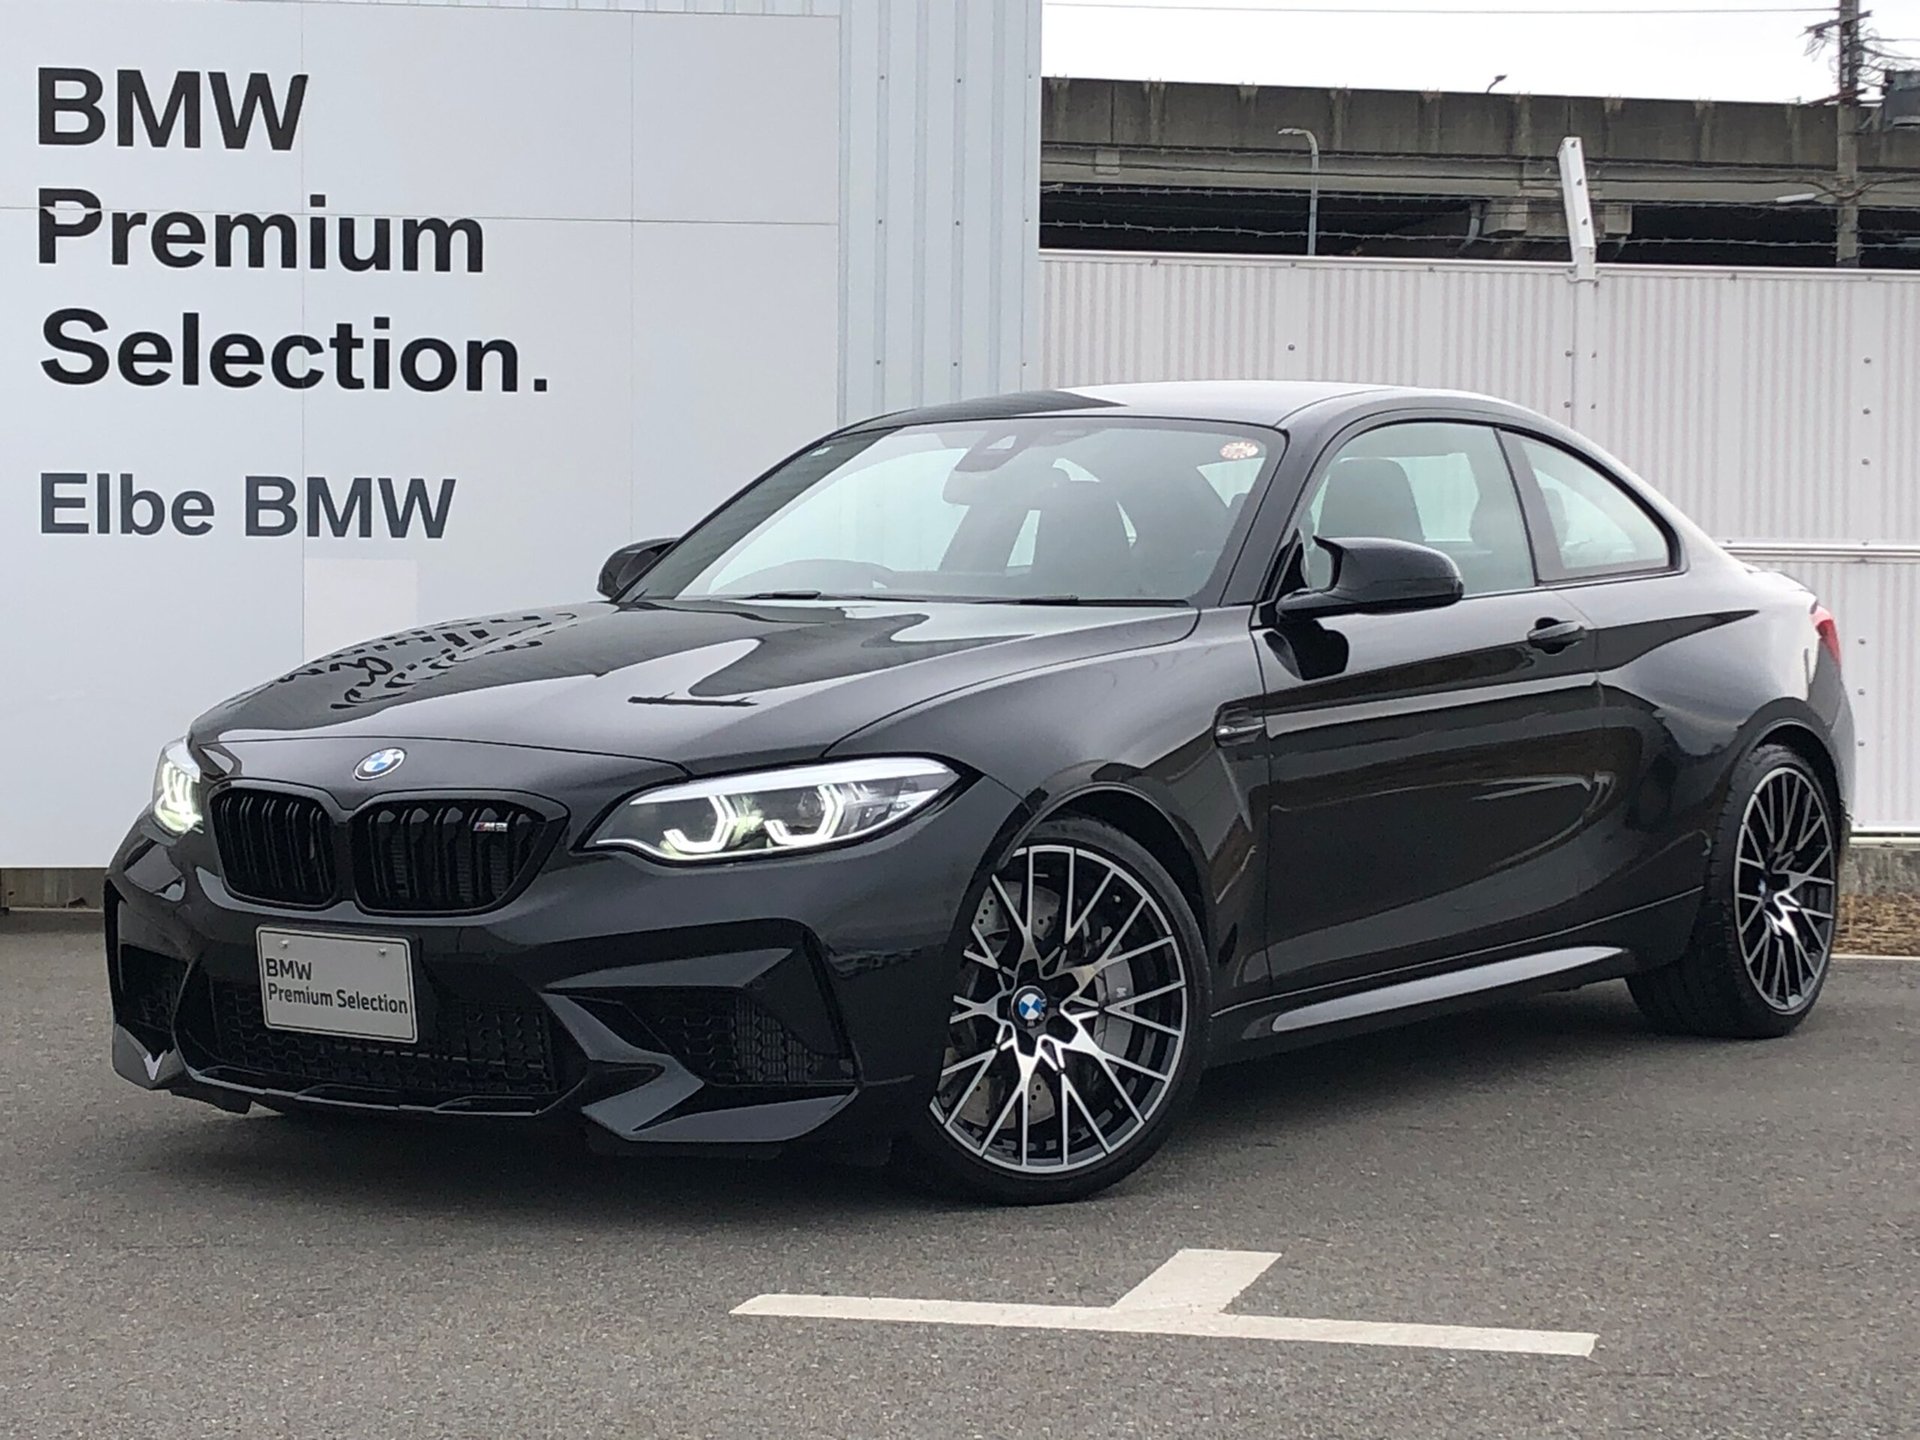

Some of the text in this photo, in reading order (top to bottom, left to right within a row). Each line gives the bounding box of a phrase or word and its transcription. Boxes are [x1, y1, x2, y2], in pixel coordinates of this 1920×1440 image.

[39, 67, 308, 150] BMW
[38, 188, 484, 272] Premium
[41, 308, 547, 392] Selection.
[41, 473, 456, 539] Elbe BMW
[265, 957, 312, 981] BMW
[267, 982, 408, 1014] Premium Selection
